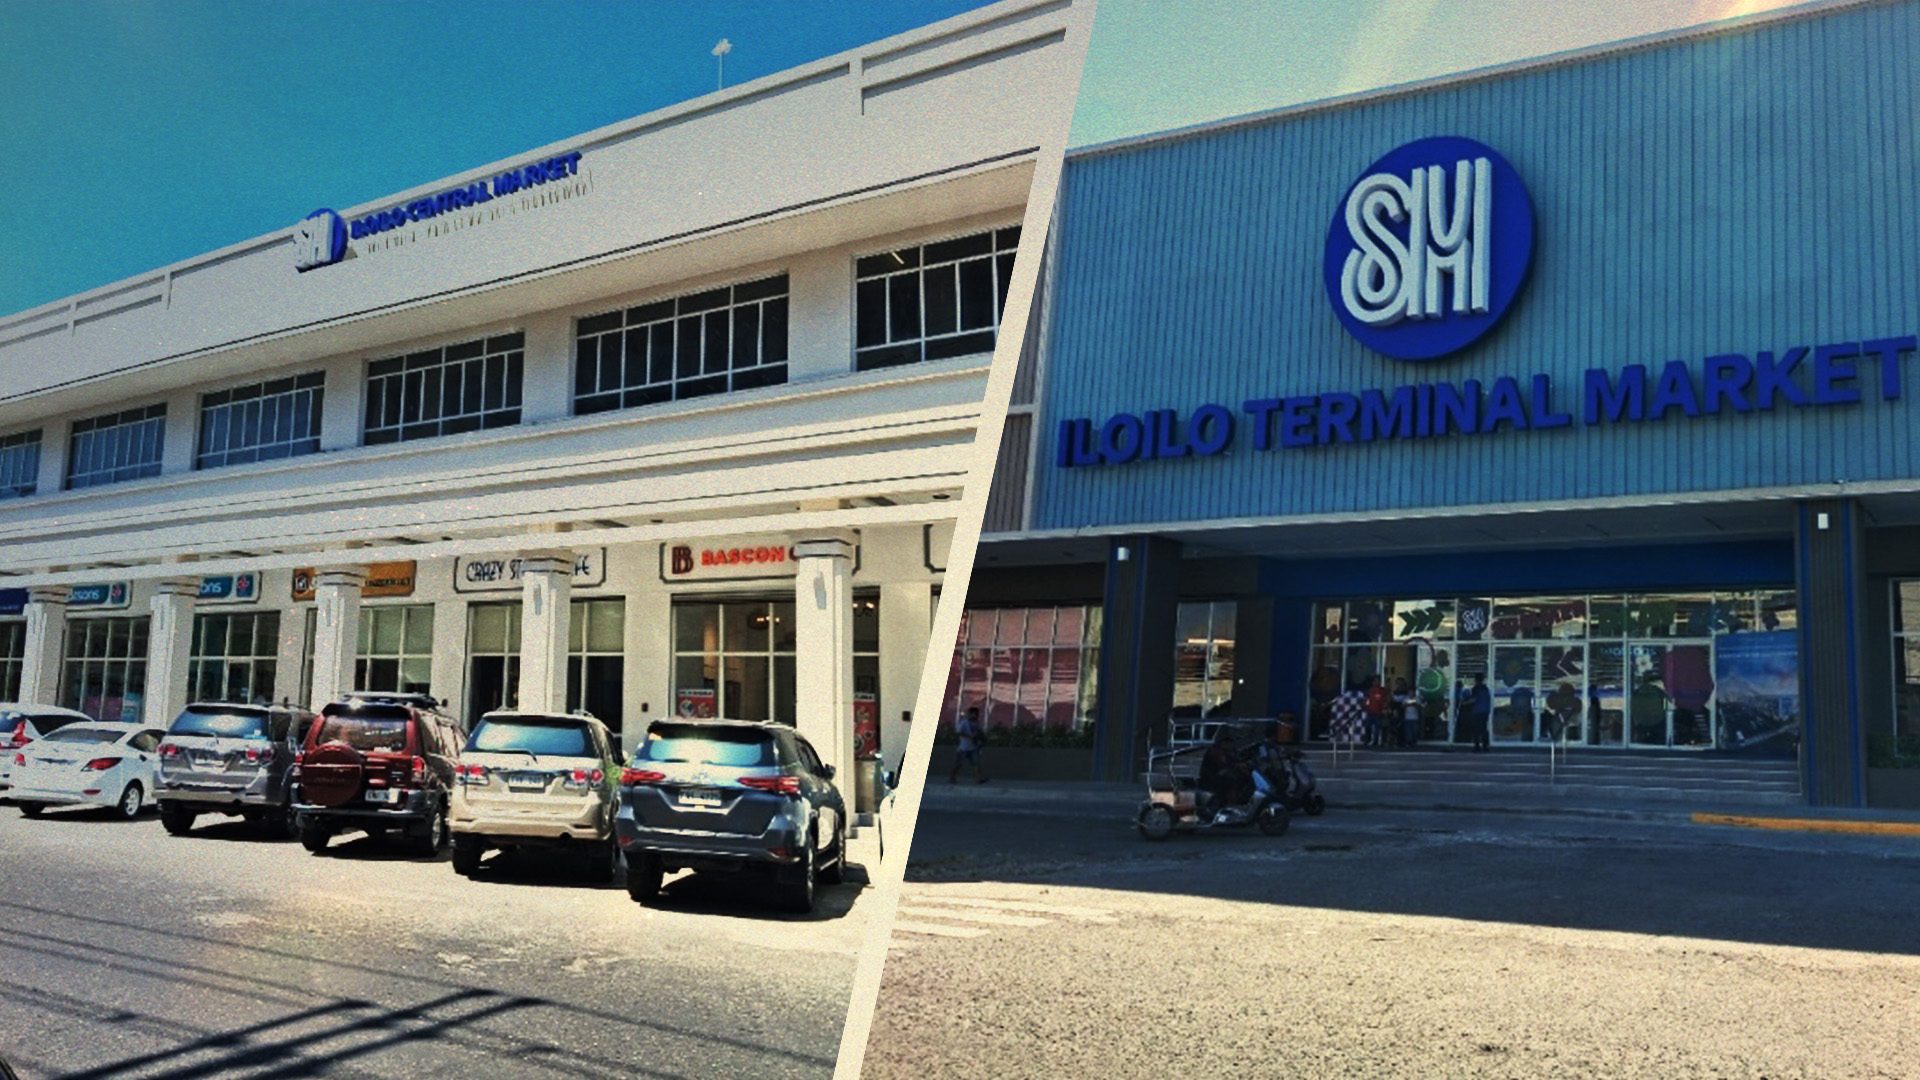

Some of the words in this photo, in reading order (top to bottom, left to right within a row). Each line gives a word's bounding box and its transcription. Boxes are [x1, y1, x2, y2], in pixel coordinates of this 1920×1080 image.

[493, 152, 583, 198] MARKET
[1341, 157, 1491, 324] SM
[1057, 404, 1234, 468] ILOILO
[1243, 374, 1572, 452] TERMINAL
[1584, 336, 1918, 426] MARKET
[702, 546, 785, 566] BASCON
